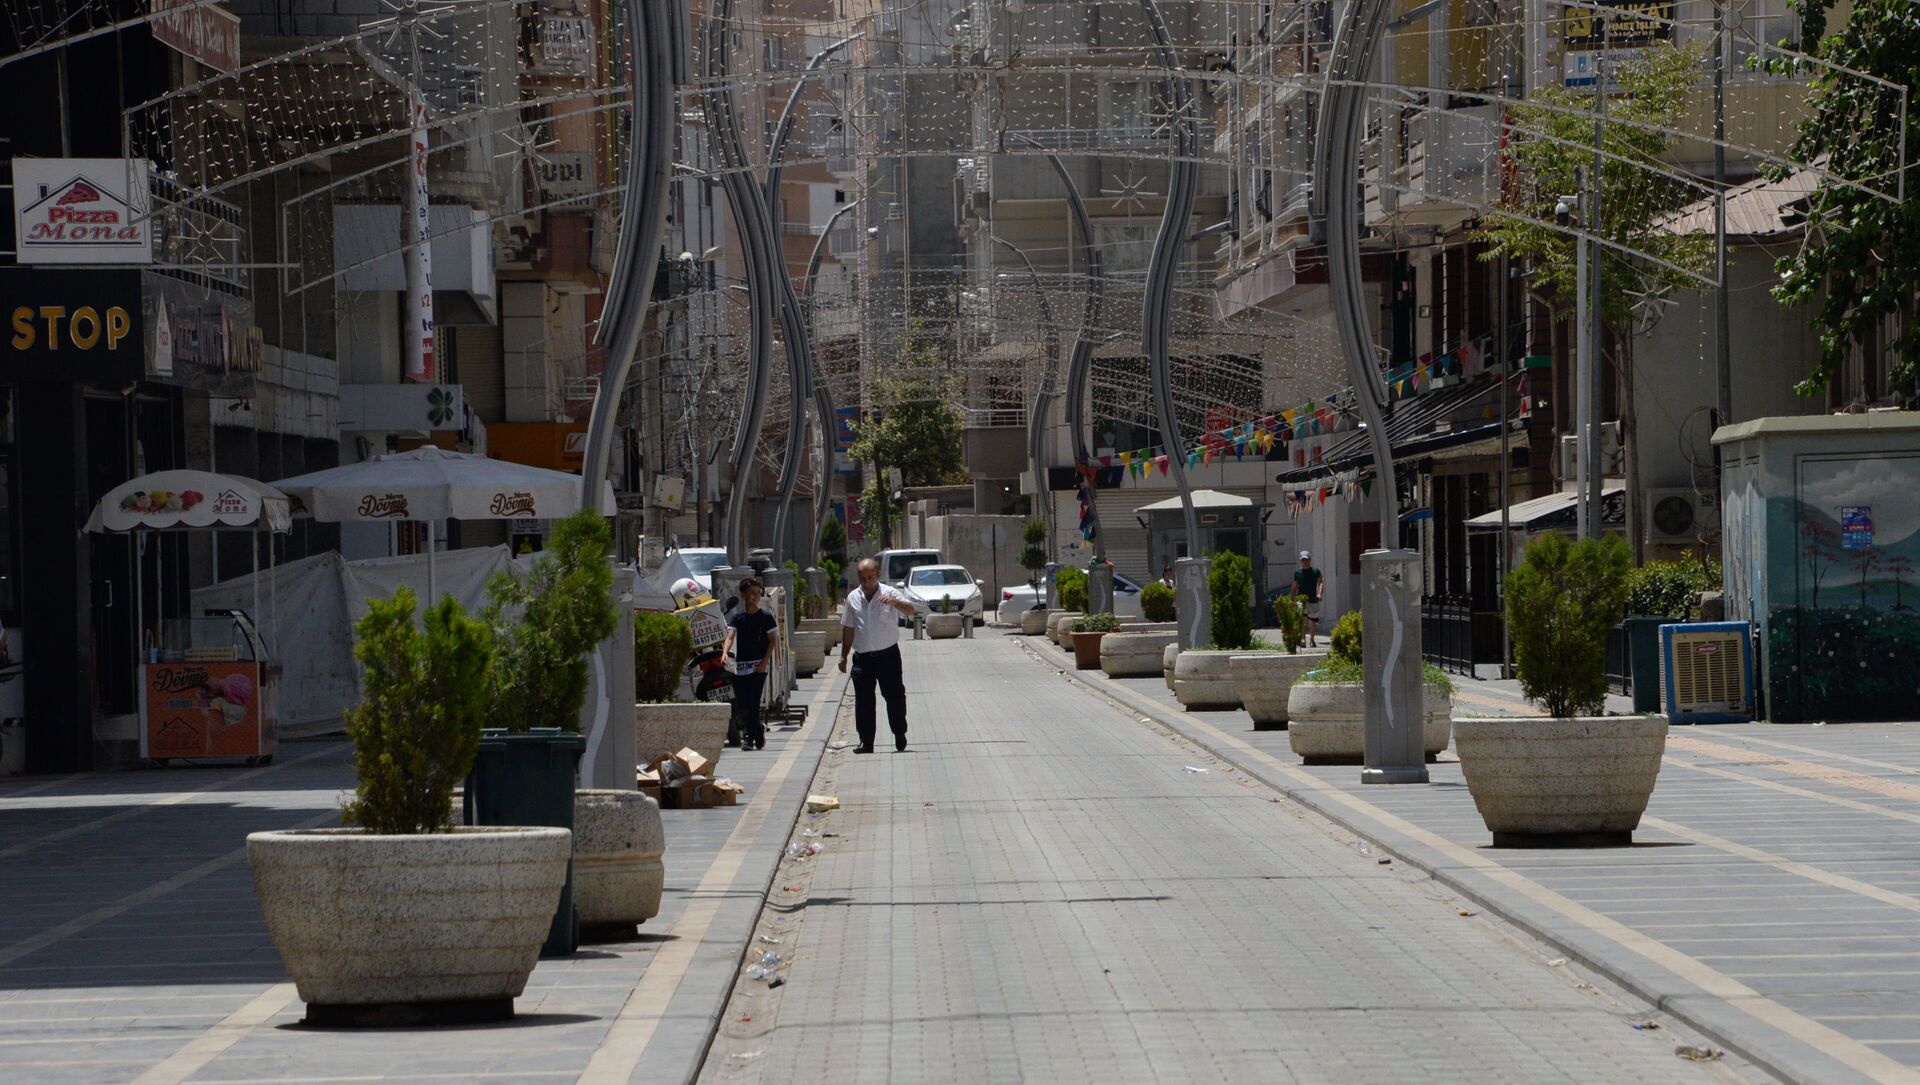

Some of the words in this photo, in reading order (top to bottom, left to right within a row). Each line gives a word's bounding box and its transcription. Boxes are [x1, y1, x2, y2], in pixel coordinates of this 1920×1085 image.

[48, 207, 119, 223] Pizza
[28, 222, 140, 240] Mona
[11, 305, 130, 350] STOP
[490, 493, 536, 516] Dövme
[692, 623, 721, 637] ona
